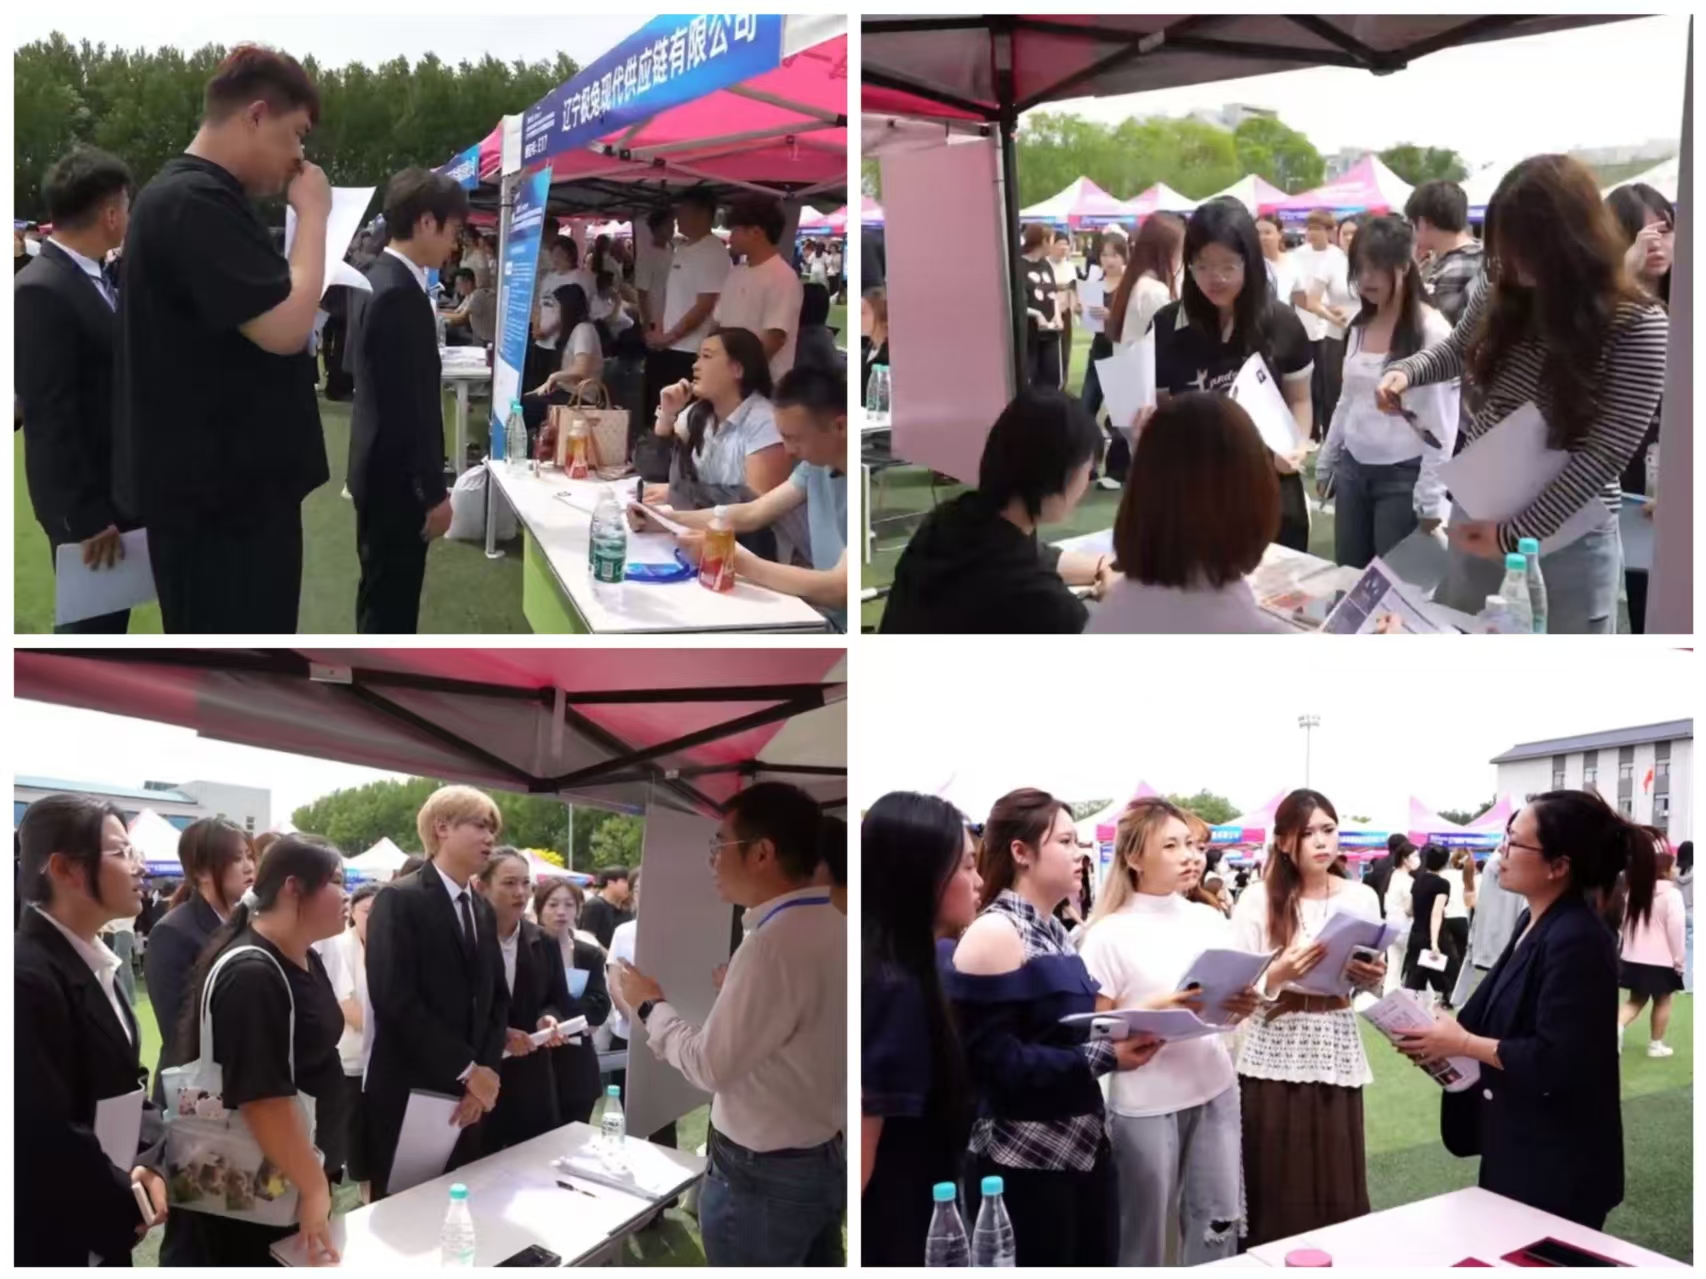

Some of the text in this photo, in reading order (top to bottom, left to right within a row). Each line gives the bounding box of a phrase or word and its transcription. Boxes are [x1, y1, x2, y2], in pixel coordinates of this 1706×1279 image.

[561, 14, 757, 132] 辽宁极兔现代供应链有限公司
